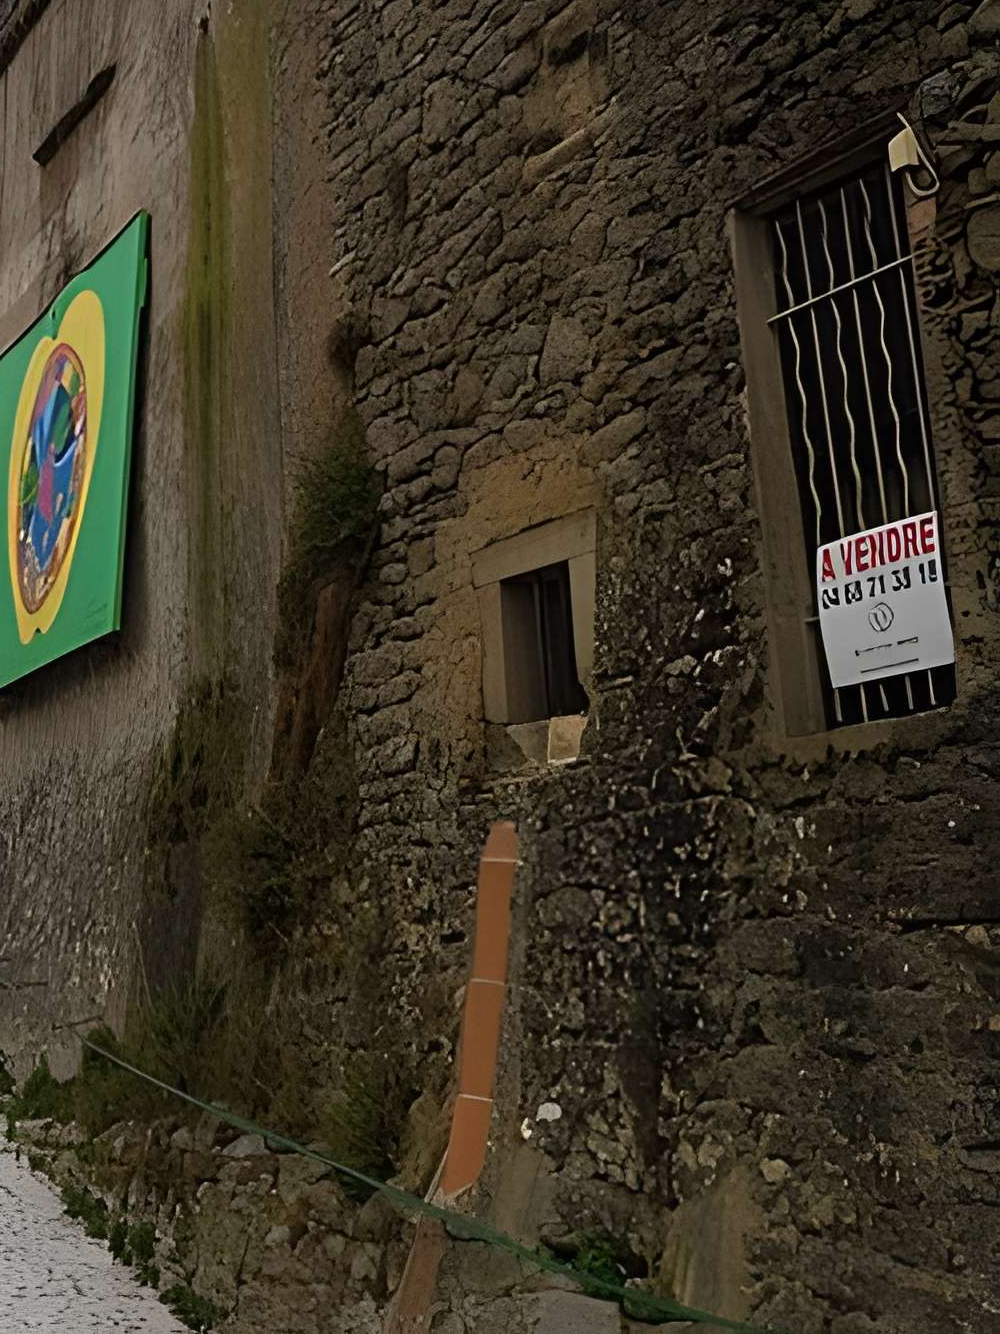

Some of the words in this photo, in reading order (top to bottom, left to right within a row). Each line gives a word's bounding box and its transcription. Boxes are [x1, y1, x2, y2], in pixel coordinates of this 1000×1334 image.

[822, 548, 836, 582] A
[840, 516, 936, 576] VENDRE
[867, 574, 886, 598] 71
